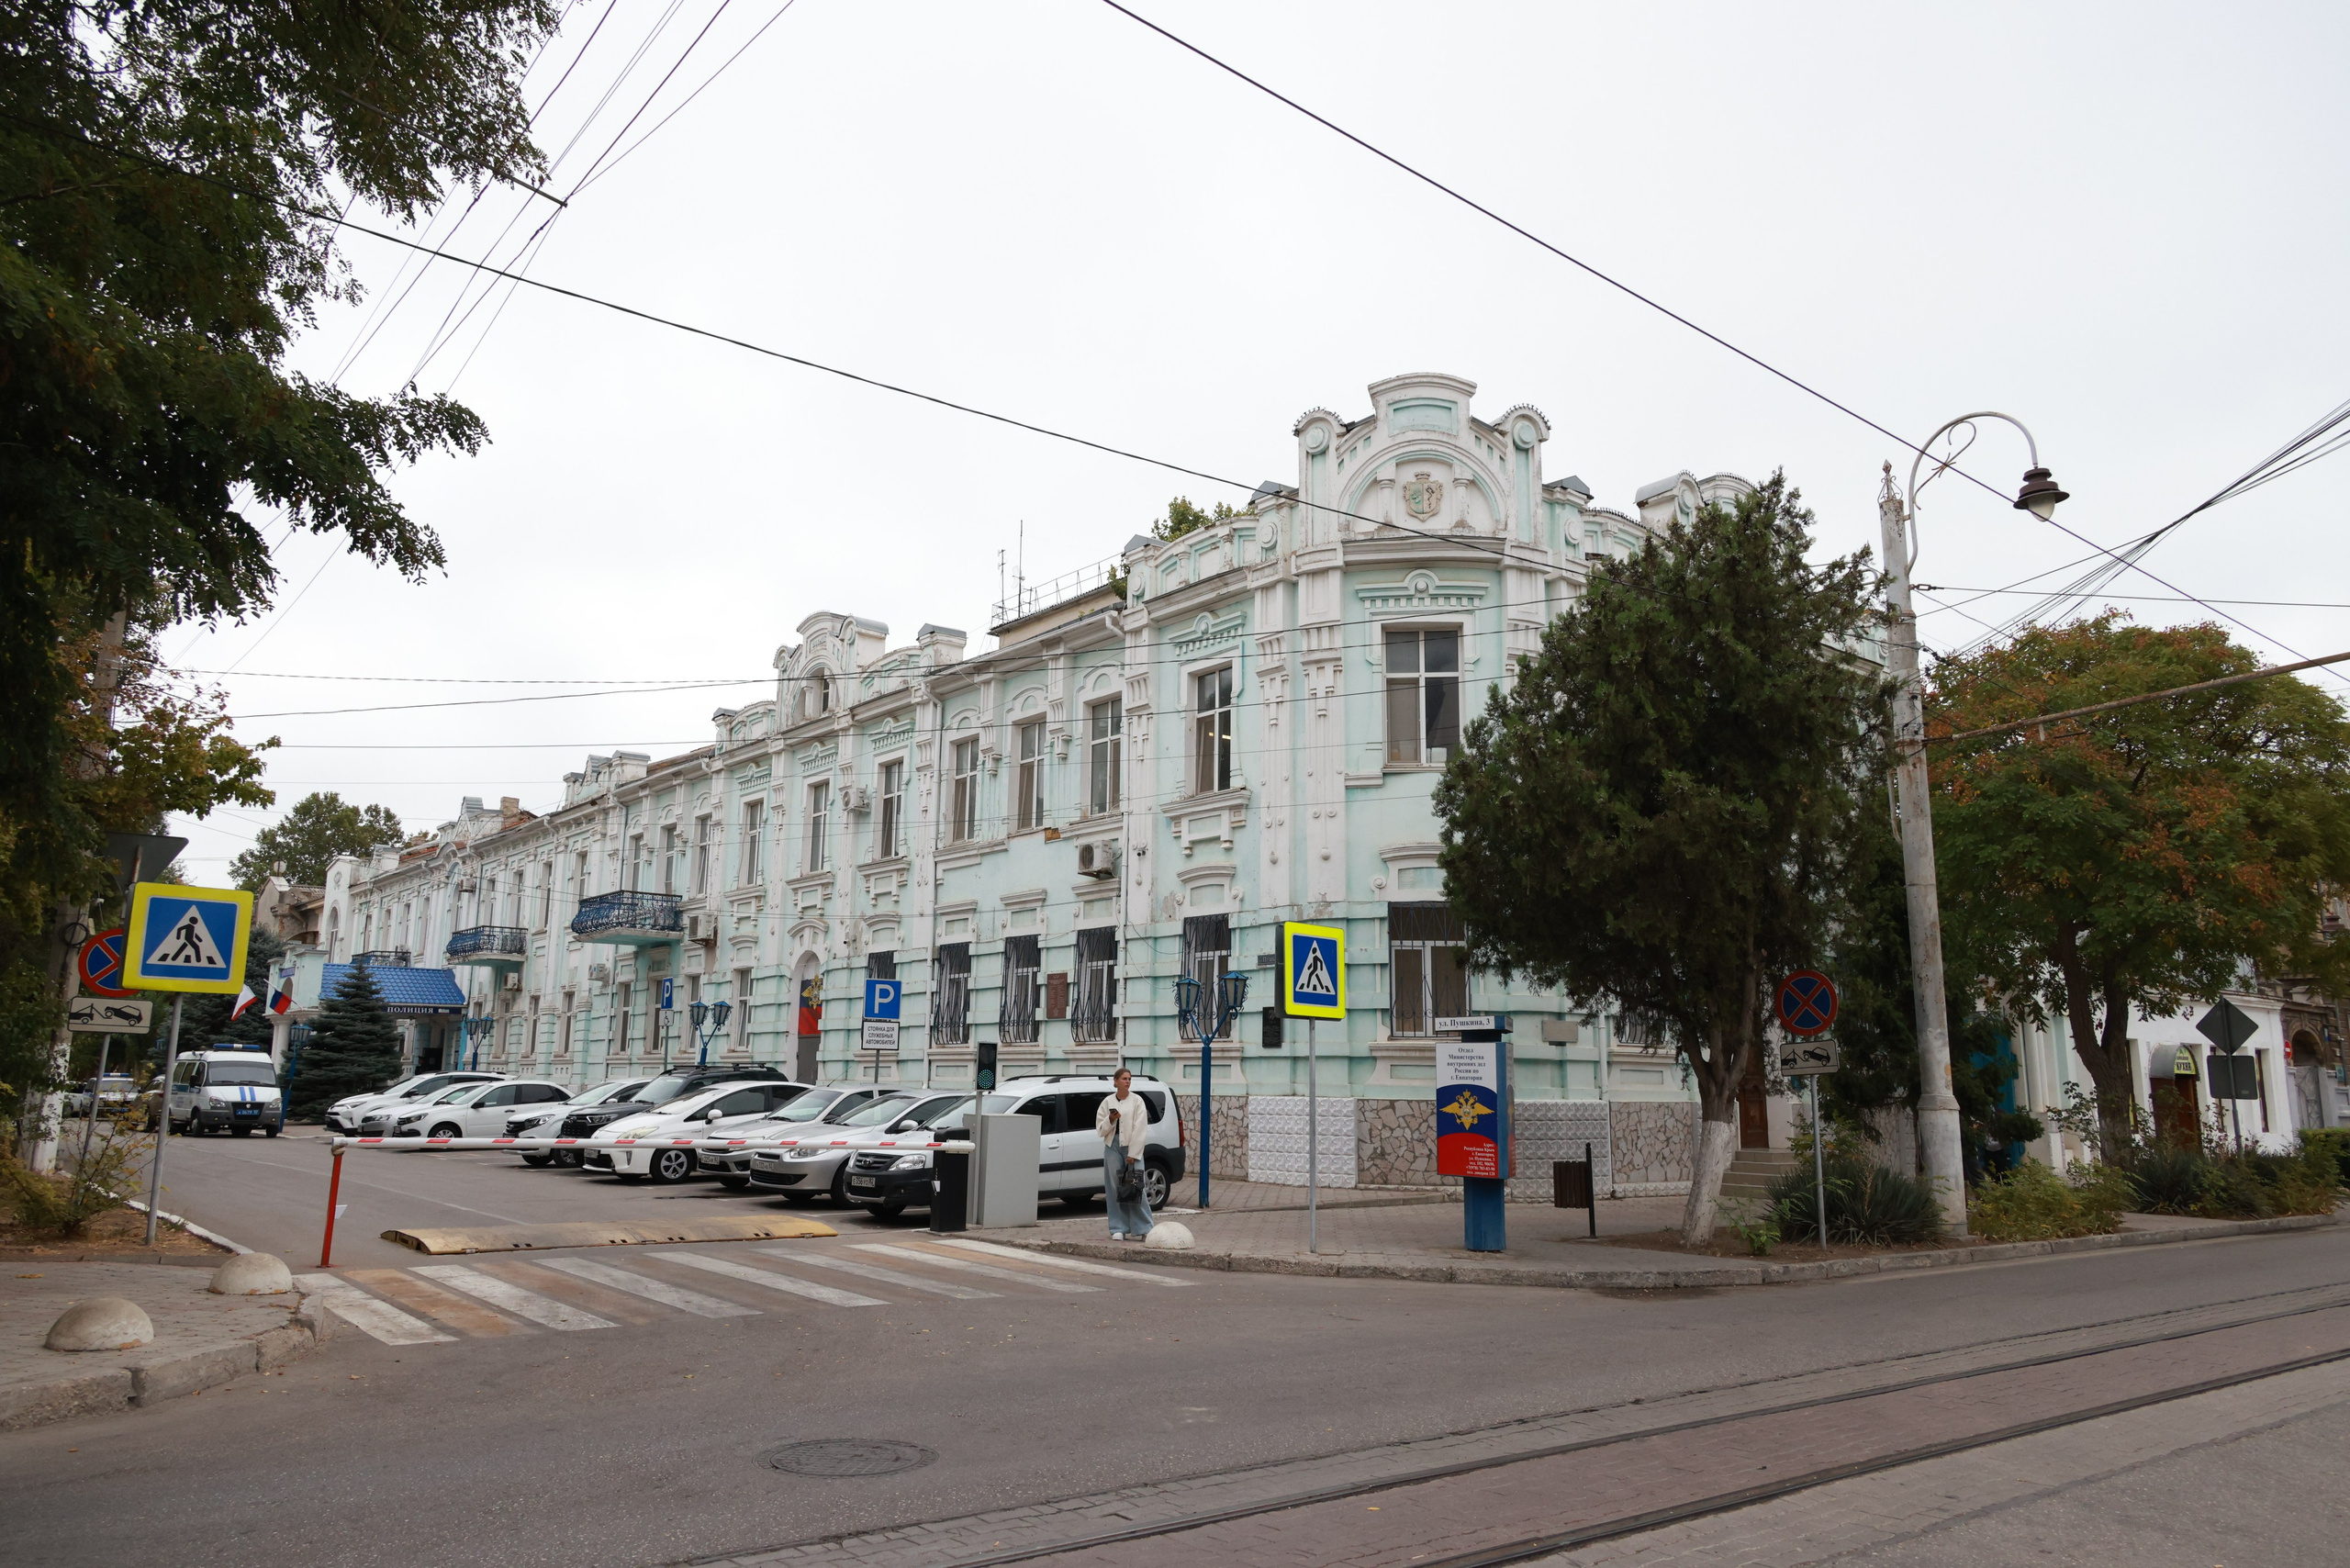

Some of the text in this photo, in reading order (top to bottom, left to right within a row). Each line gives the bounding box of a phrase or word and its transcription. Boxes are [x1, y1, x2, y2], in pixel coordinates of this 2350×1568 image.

[664, 981, 671, 1006] P
[874, 984, 895, 1014] P
[1450, 1019, 1484, 1028] Пушкина,
